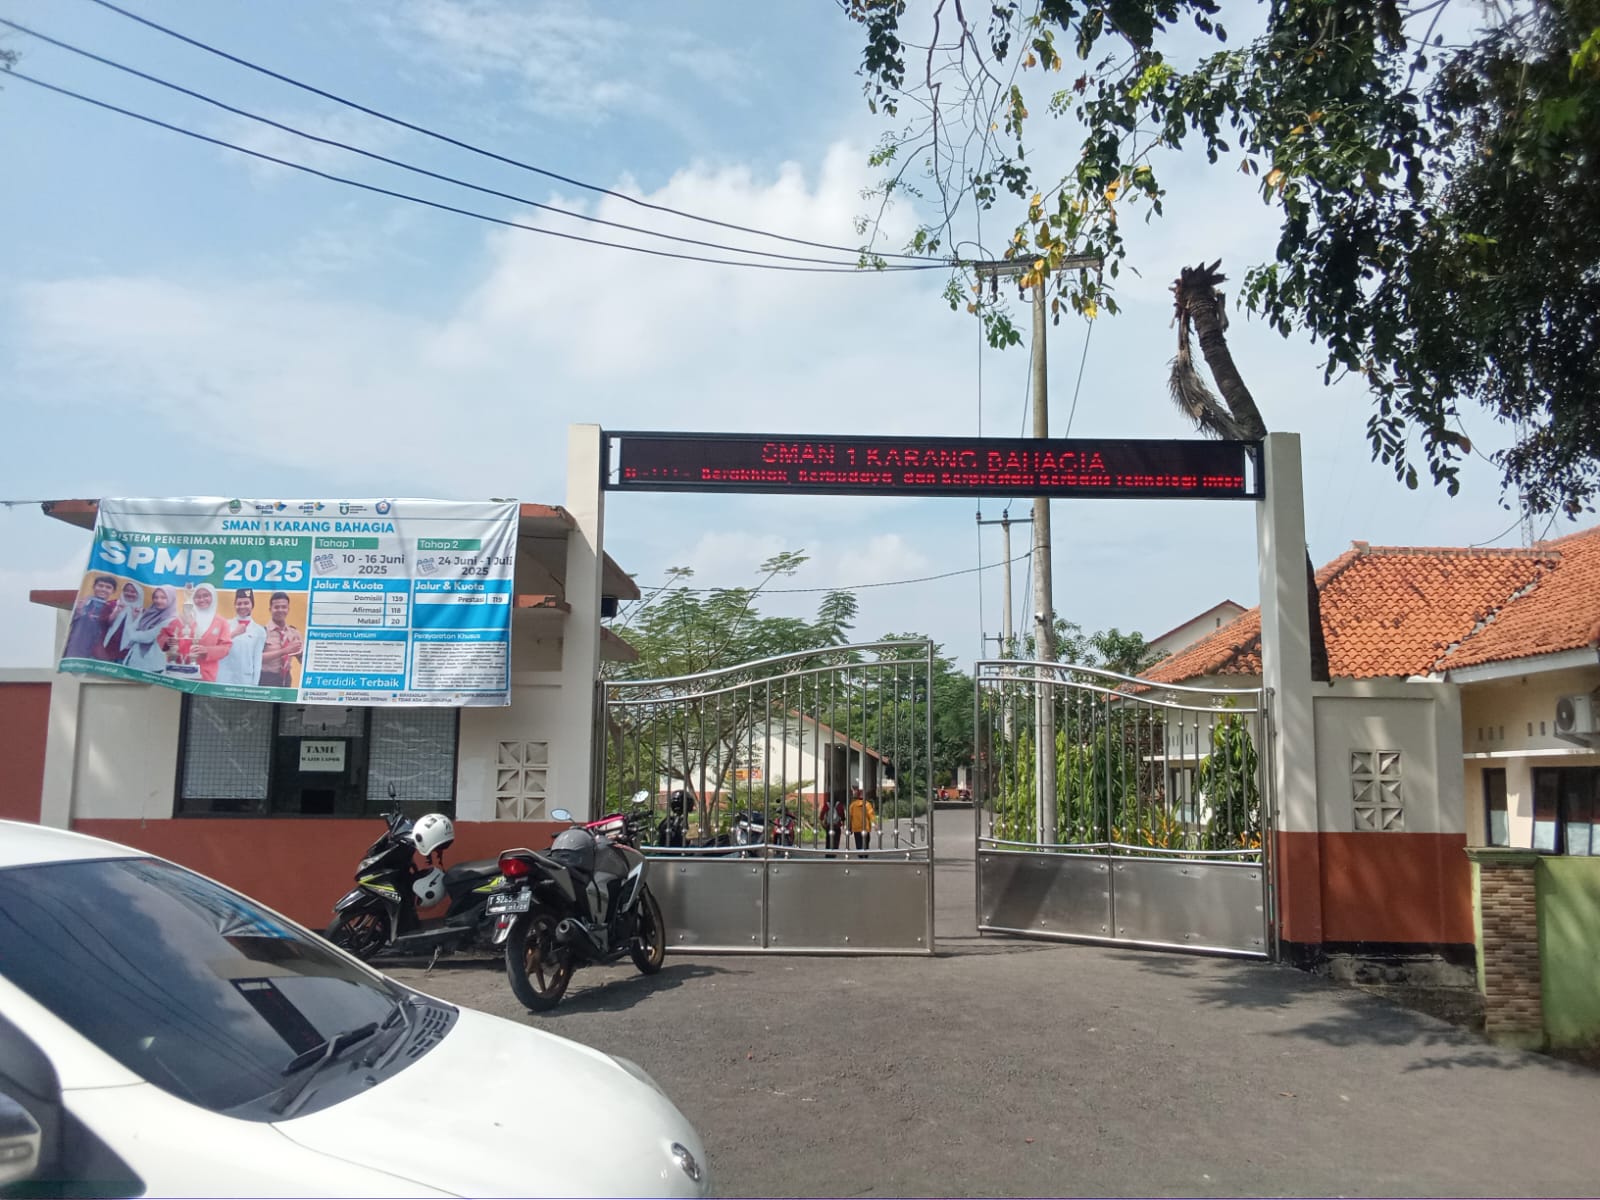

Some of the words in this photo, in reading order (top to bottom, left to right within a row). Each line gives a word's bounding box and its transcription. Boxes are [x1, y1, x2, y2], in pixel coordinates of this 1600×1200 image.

[847, 447, 856, 465] 1
[903, 472, 936, 485] dan
[222, 520, 261, 532] SMAN
[265, 521, 270, 532] 1
[273, 521, 331, 533] KARANG
[334, 522, 395, 534] BAHAGIA
[110, 530, 151, 544] SISTEM
[154, 535, 227, 546] PENERIMAAN
[230, 537, 266, 547] MURID
[269, 537, 300, 547] BARU
[319, 539, 349, 548] Tahap
[351, 539, 356, 548] 1
[421, 539, 450, 549] Tahap
[452, 540, 459, 549] 2
[99, 540, 215, 576] SPMB
[223, 559, 303, 582] 2025
[342, 554, 356, 564] 10
[365, 554, 377, 564] 16
[379, 554, 405, 565] Juni
[438, 556, 451, 565] 24
[454, 556, 477, 566] Juni
[493, 556, 512, 566] Juli
[358, 565, 388, 575] 2025
[461, 567, 489, 576] 2025
[314, 580, 340, 590] Jalur
[342, 580, 350, 589] &
[353, 580, 384, 590] Kuota
[415, 581, 441, 590] Jalur
[443, 581, 452, 591] &
[454, 581, 485, 591] Kuota
[354, 594, 383, 602] Domisili
[352, 606, 382, 614] Afirmasi
[357, 617, 381, 625] Mutasi
[316, 676, 357, 687] Terdidik
[360, 677, 400, 688] Terbaik
[305, 745, 337, 753] TAMU
